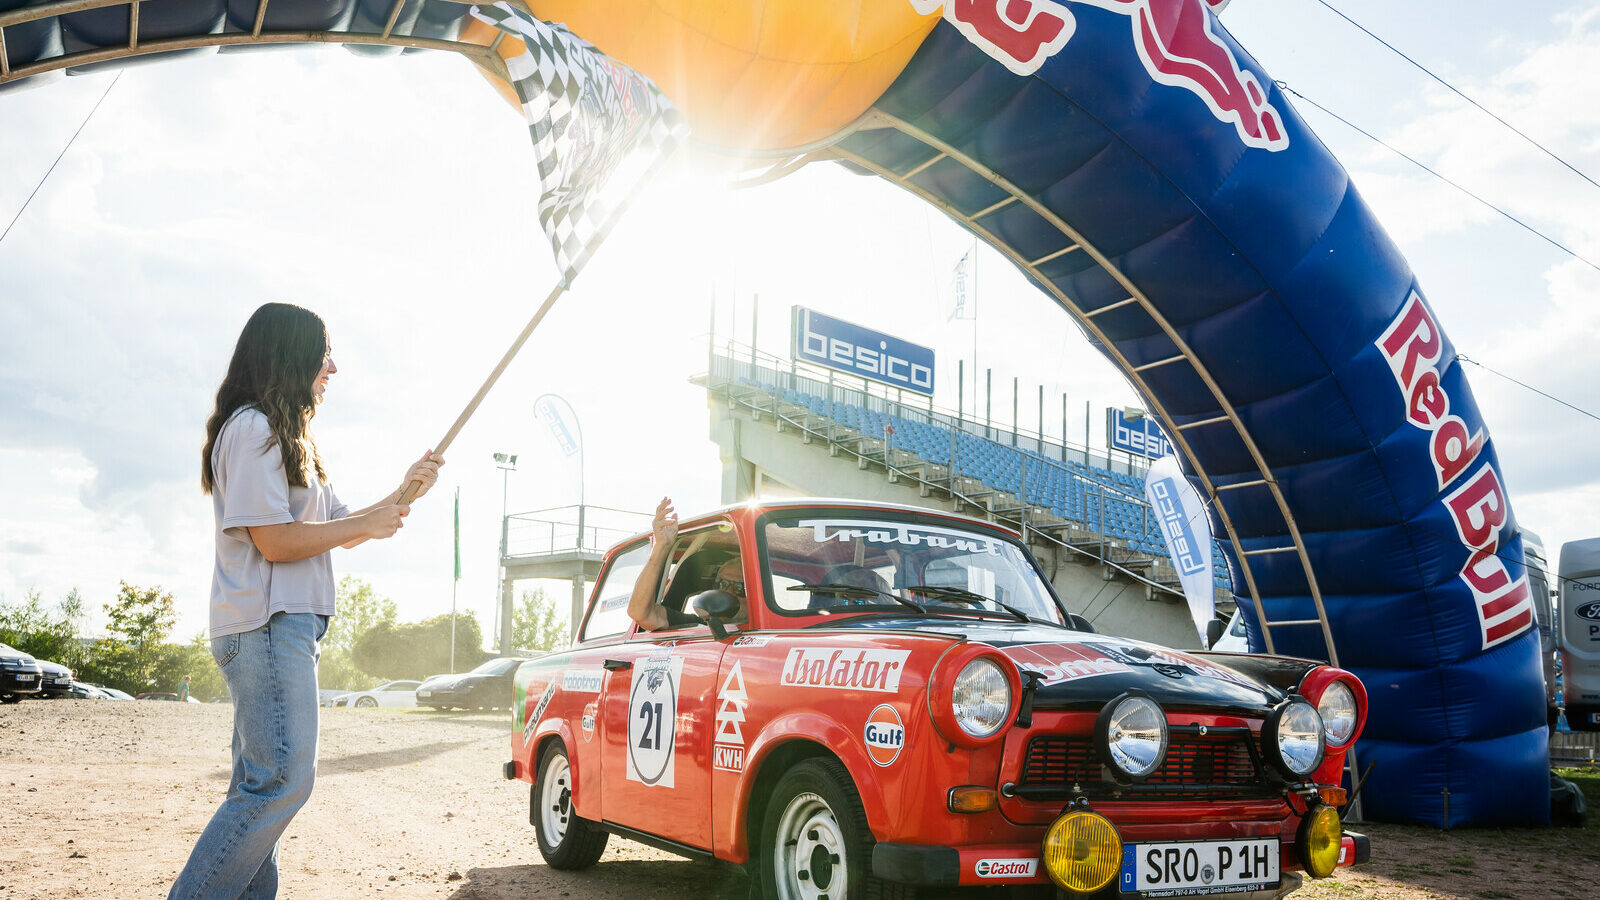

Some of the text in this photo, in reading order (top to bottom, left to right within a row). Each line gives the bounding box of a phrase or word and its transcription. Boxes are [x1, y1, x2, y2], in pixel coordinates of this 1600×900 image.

[804, 309, 932, 389] besico
[1379, 293, 1533, 647] Red Bull
[797, 519, 1003, 557] Trabant
[785, 649, 899, 690] Isolator
[563, 672, 601, 690] robotron
[582, 717, 595, 729] Gulf
[638, 701, 663, 750] 21
[866, 724, 903, 746] Gulf
[715, 747, 743, 769] KWH
[990, 861, 1030, 875] Castrol
[1146, 844, 1269, 884] SRO P 1H
[1125, 872, 1132, 884] D
[1197, 887, 1209, 896] Vogel
[1210, 886, 1224, 894] GmbH
